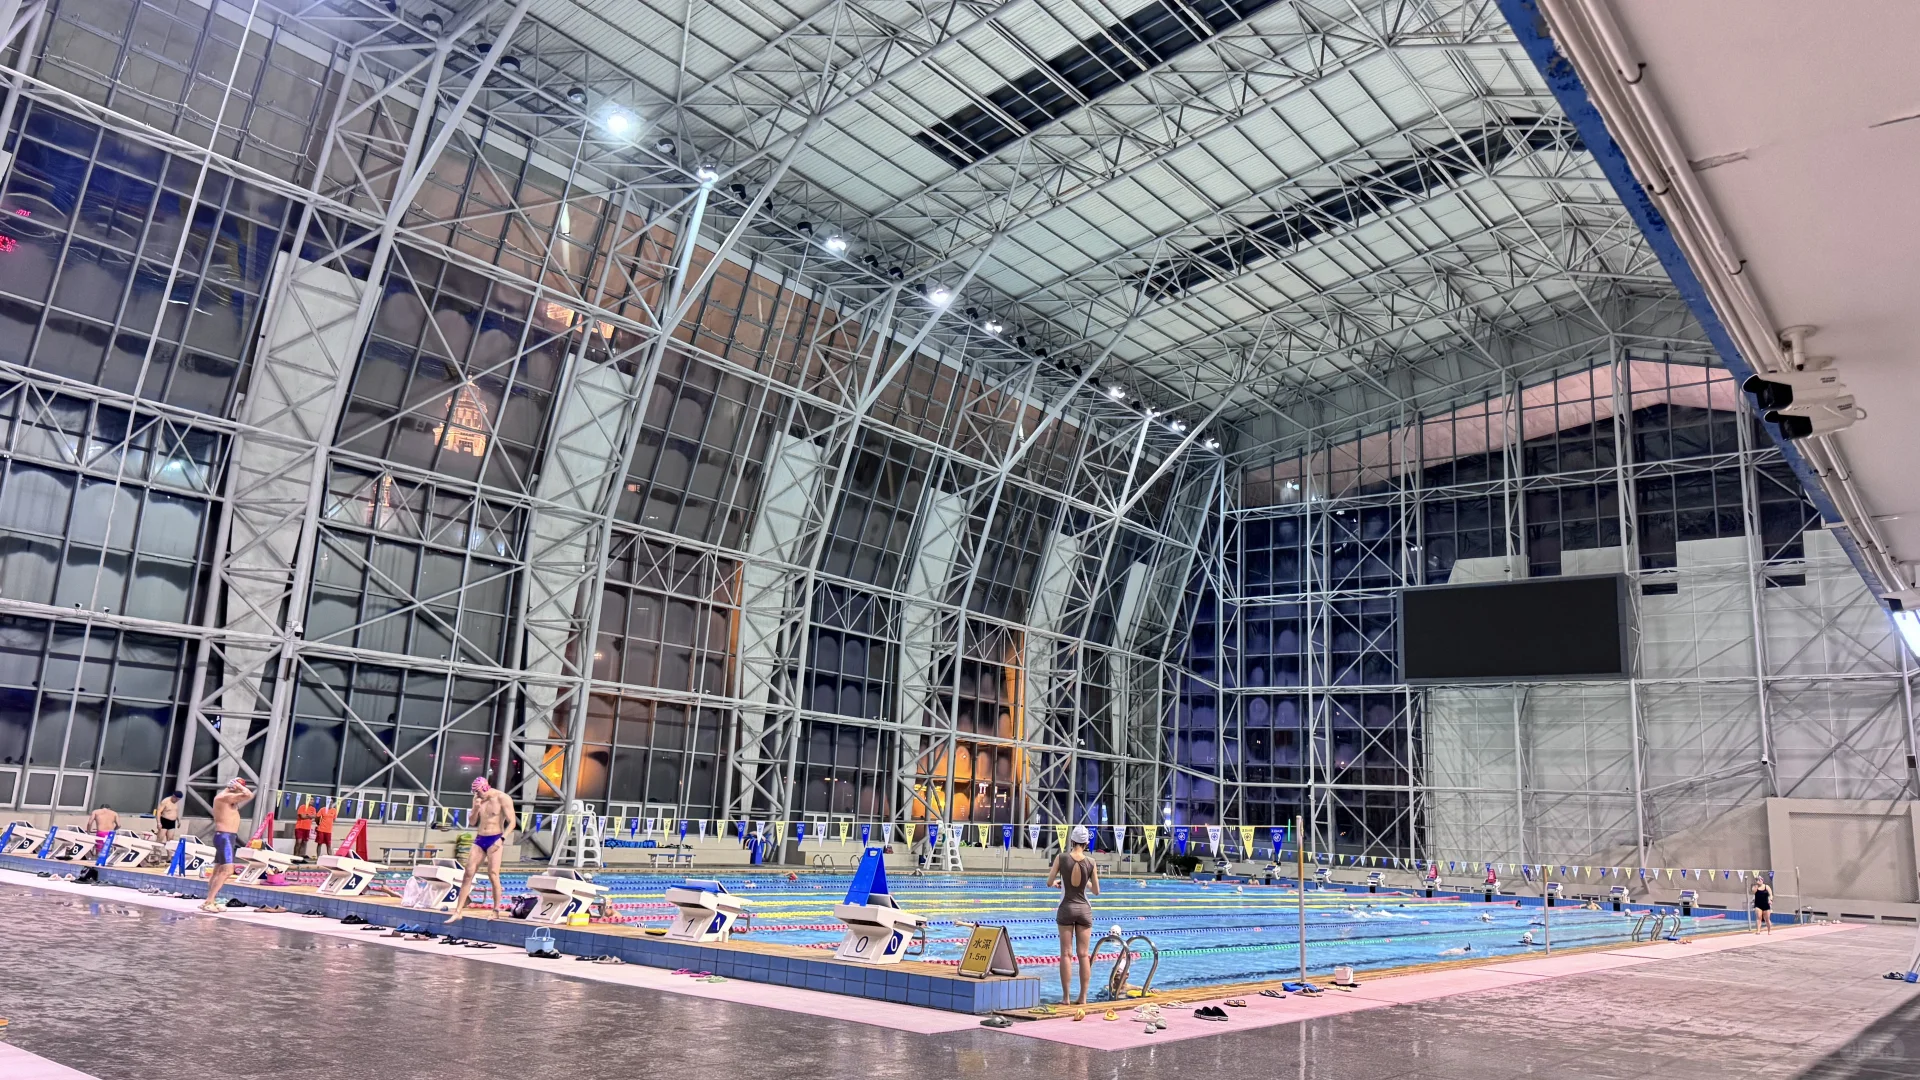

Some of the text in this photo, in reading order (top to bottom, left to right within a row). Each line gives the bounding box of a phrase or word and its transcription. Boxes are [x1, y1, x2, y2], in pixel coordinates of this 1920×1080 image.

[23, 840, 30, 848] 9
[73, 846, 79, 854] 8
[128, 853, 135, 861] 7
[192, 859, 200, 868] 6
[348, 877, 357, 888] 4
[449, 888, 457, 900] 3
[542, 902, 553, 916] 2
[569, 901, 577, 914] 2
[685, 917, 696, 932] 1
[715, 917, 721, 931] 1
[855, 936, 869, 953] 0
[890, 935, 898, 952] 0
[972, 938, 992, 950] 水深
[968, 952, 987, 962] 1.5m
